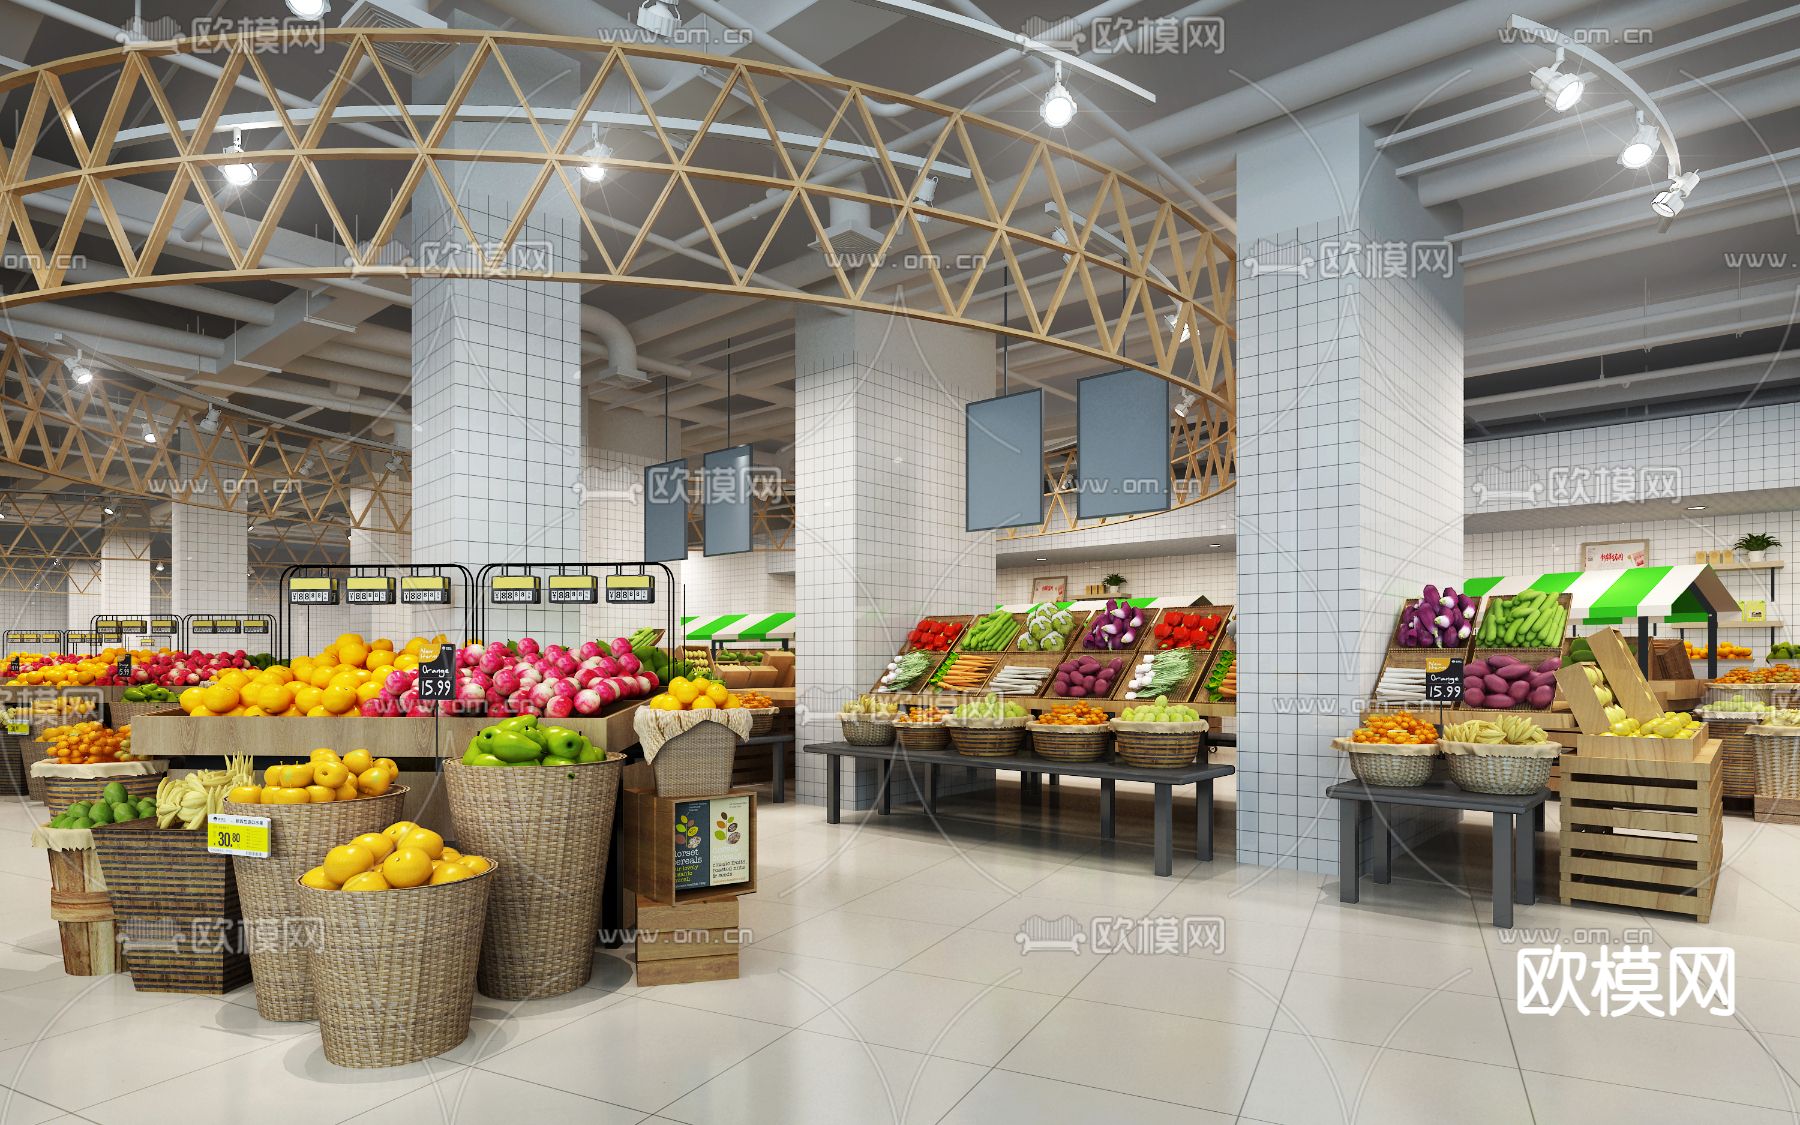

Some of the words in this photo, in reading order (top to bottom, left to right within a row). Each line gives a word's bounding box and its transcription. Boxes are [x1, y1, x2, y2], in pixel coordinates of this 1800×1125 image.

[422, 665, 450, 678] Orange
[1430, 674, 1460, 684] Orange
[421, 680, 451, 696] 15.99
[1430, 686, 1461, 698] 15.99
